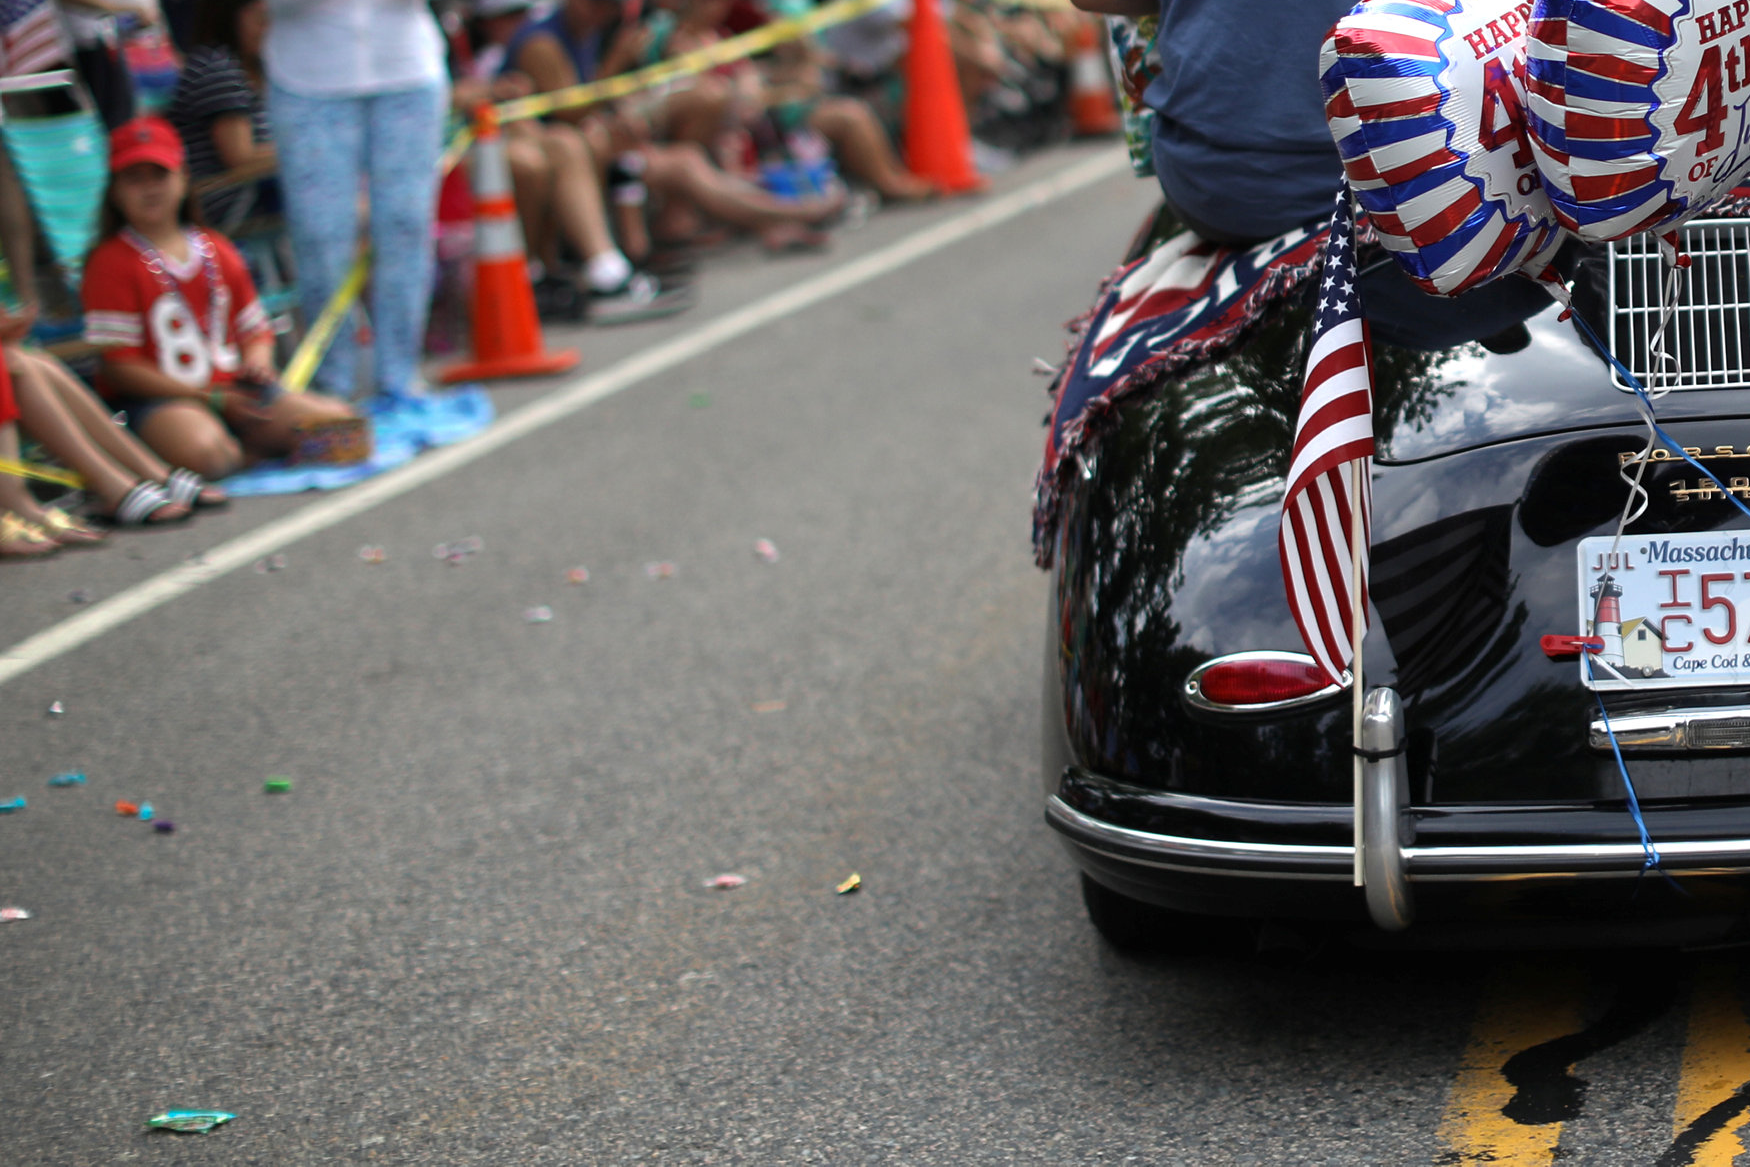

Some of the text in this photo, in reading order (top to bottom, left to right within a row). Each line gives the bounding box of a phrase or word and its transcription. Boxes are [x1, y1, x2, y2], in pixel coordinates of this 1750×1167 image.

[1688, 156, 1719, 182] OF
[1593, 552, 1635, 571] JUL
[1673, 655, 1708, 673] Cape
[1711, 654, 1739, 668] Cod
